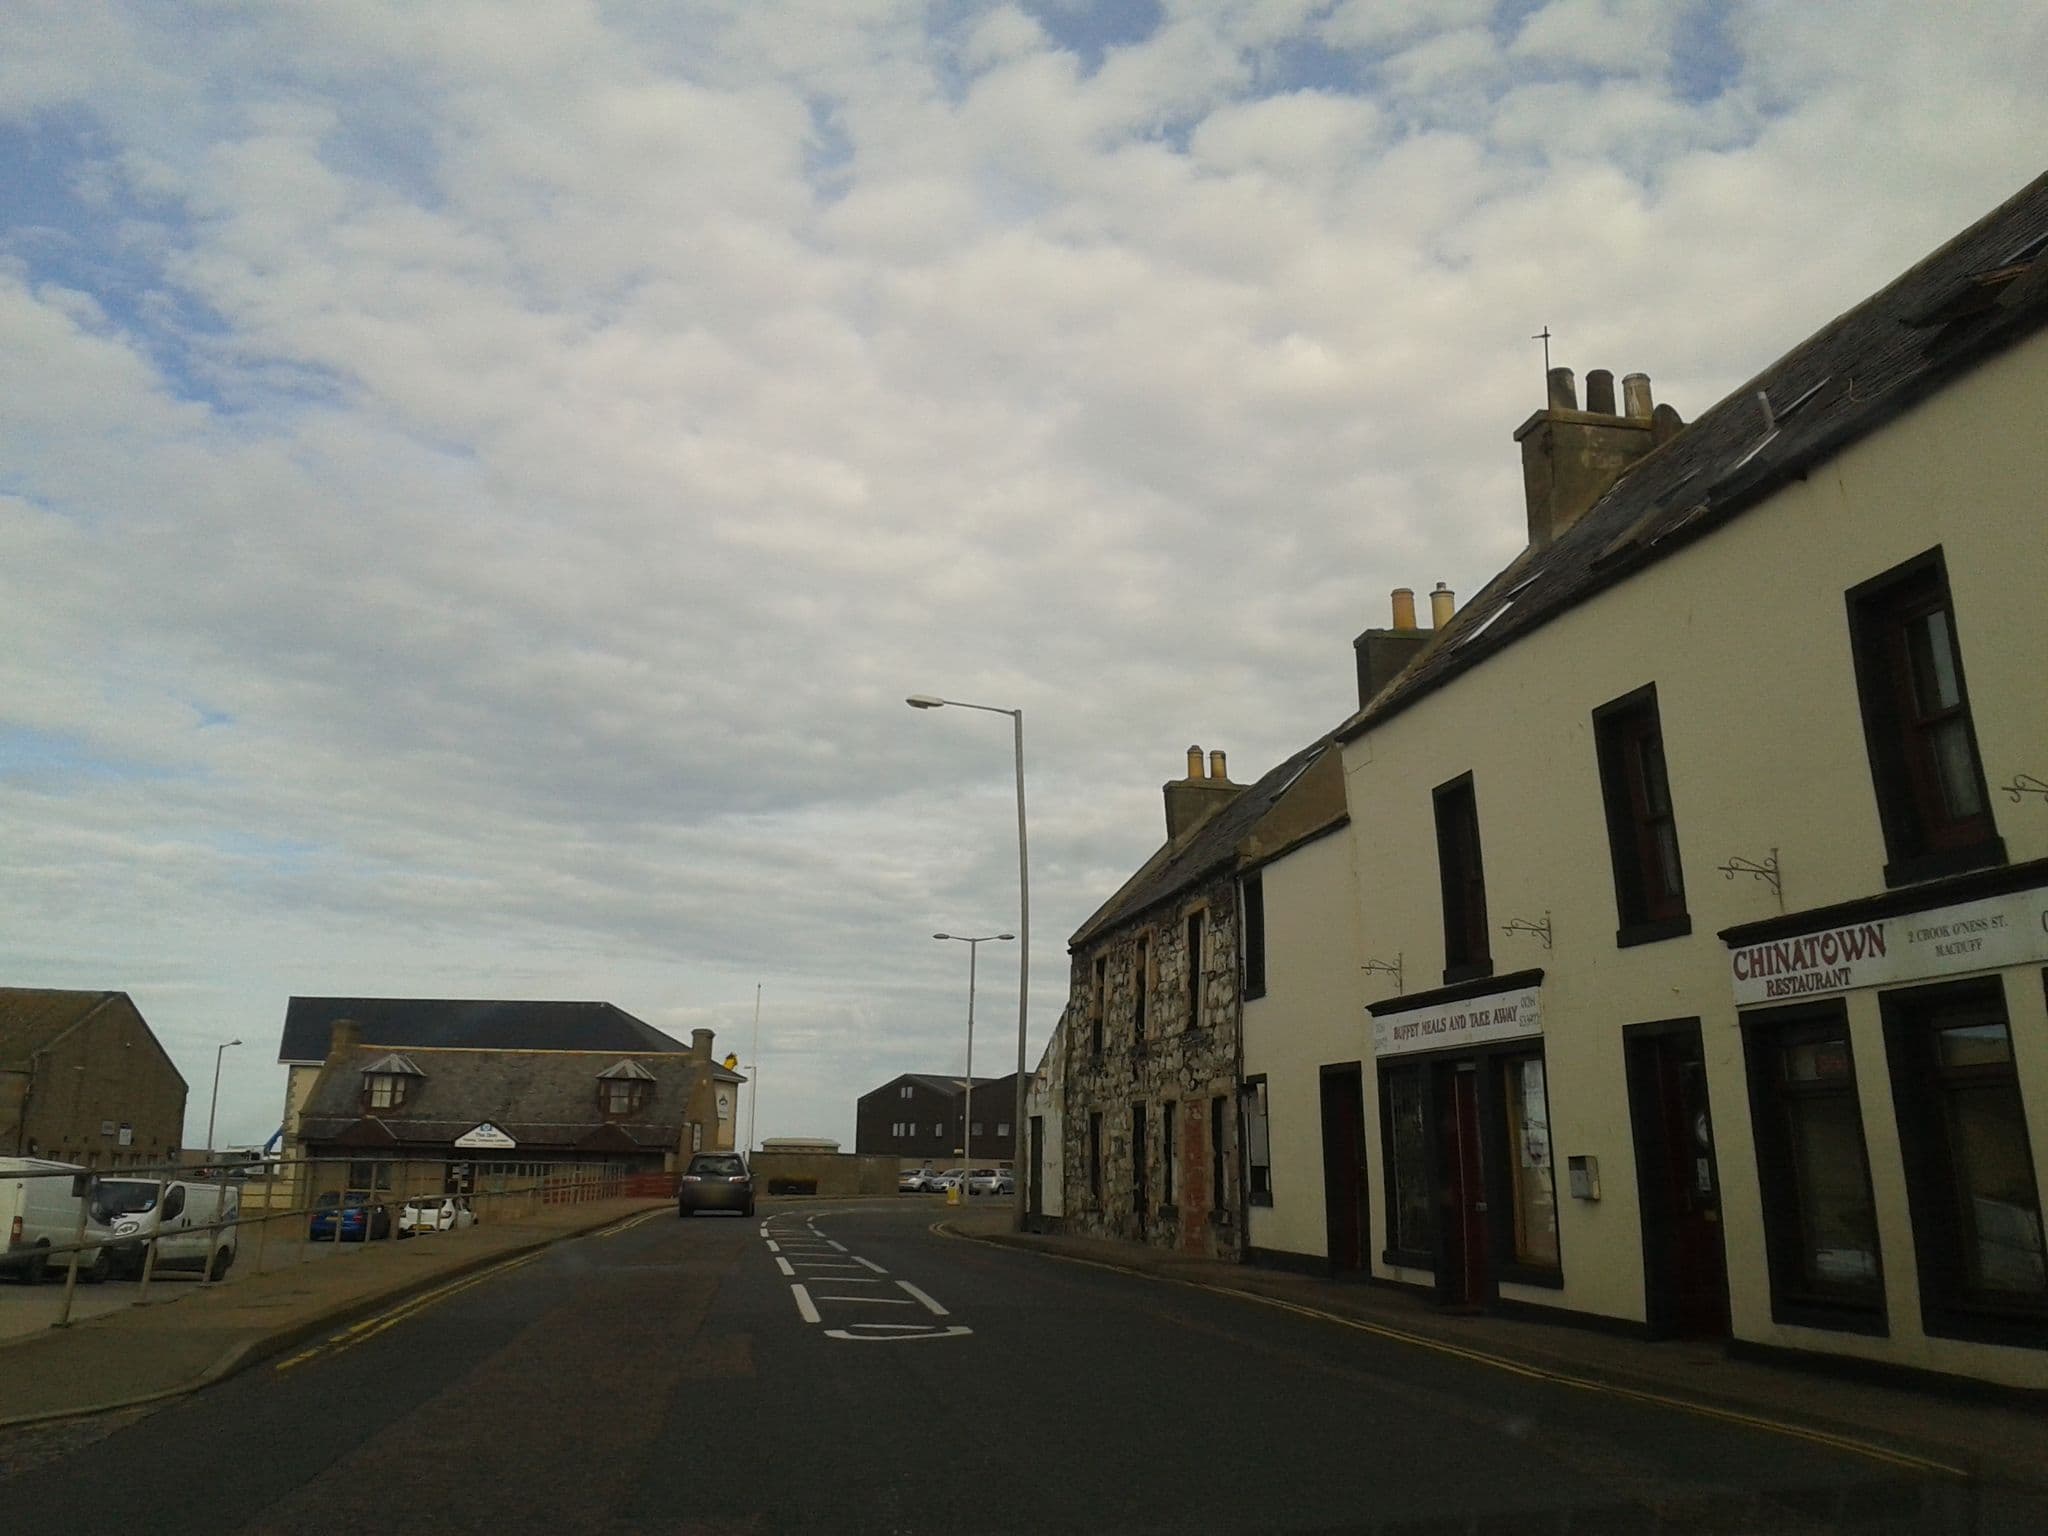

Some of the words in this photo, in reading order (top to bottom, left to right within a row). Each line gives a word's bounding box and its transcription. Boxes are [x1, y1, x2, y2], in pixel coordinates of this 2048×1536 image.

[1917, 925, 1951, 942] CROOK
[1935, 937, 1983, 958] MACDUFF
[1733, 924, 1887, 981] CHINATOWN
[1766, 967, 1851, 998] RESTAURANT
[1393, 1022, 1419, 1041] BUFFET
[1421, 1017, 1447, 1035] MEALS
[1449, 1014, 1467, 1031] AND
[1468, 1010, 1490, 1028] TAKE
[1493, 1005, 1519, 1025] AWAY
